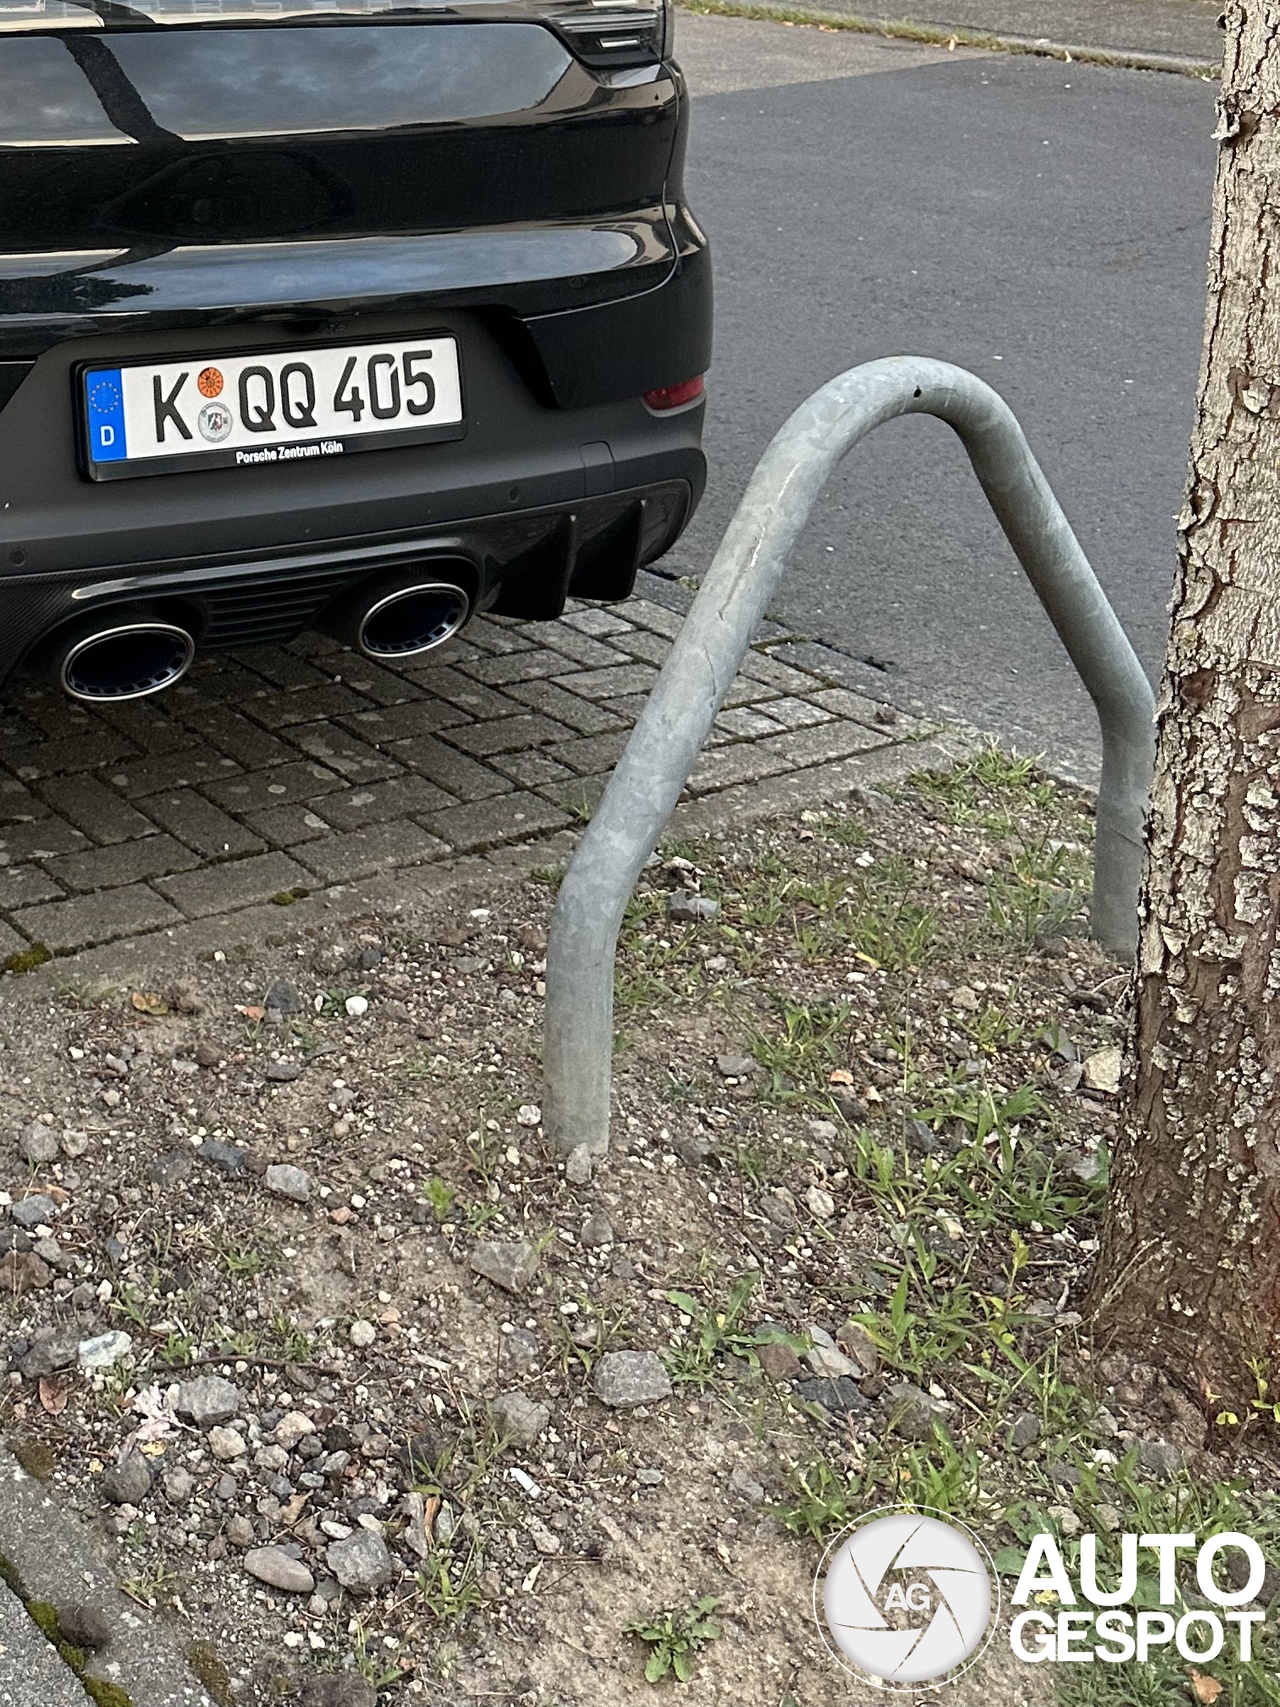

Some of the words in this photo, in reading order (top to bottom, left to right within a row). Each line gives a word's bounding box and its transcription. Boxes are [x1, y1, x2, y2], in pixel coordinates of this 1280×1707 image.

[152, 372, 193, 443] K
[238, 362, 318, 432] QQ
[333, 349, 436, 422] 405
[100, 424, 115, 446] D
[235, 448, 277, 464] Porsche
[277, 444, 320, 460] Zentrum
[320, 440, 343, 455] Köln
